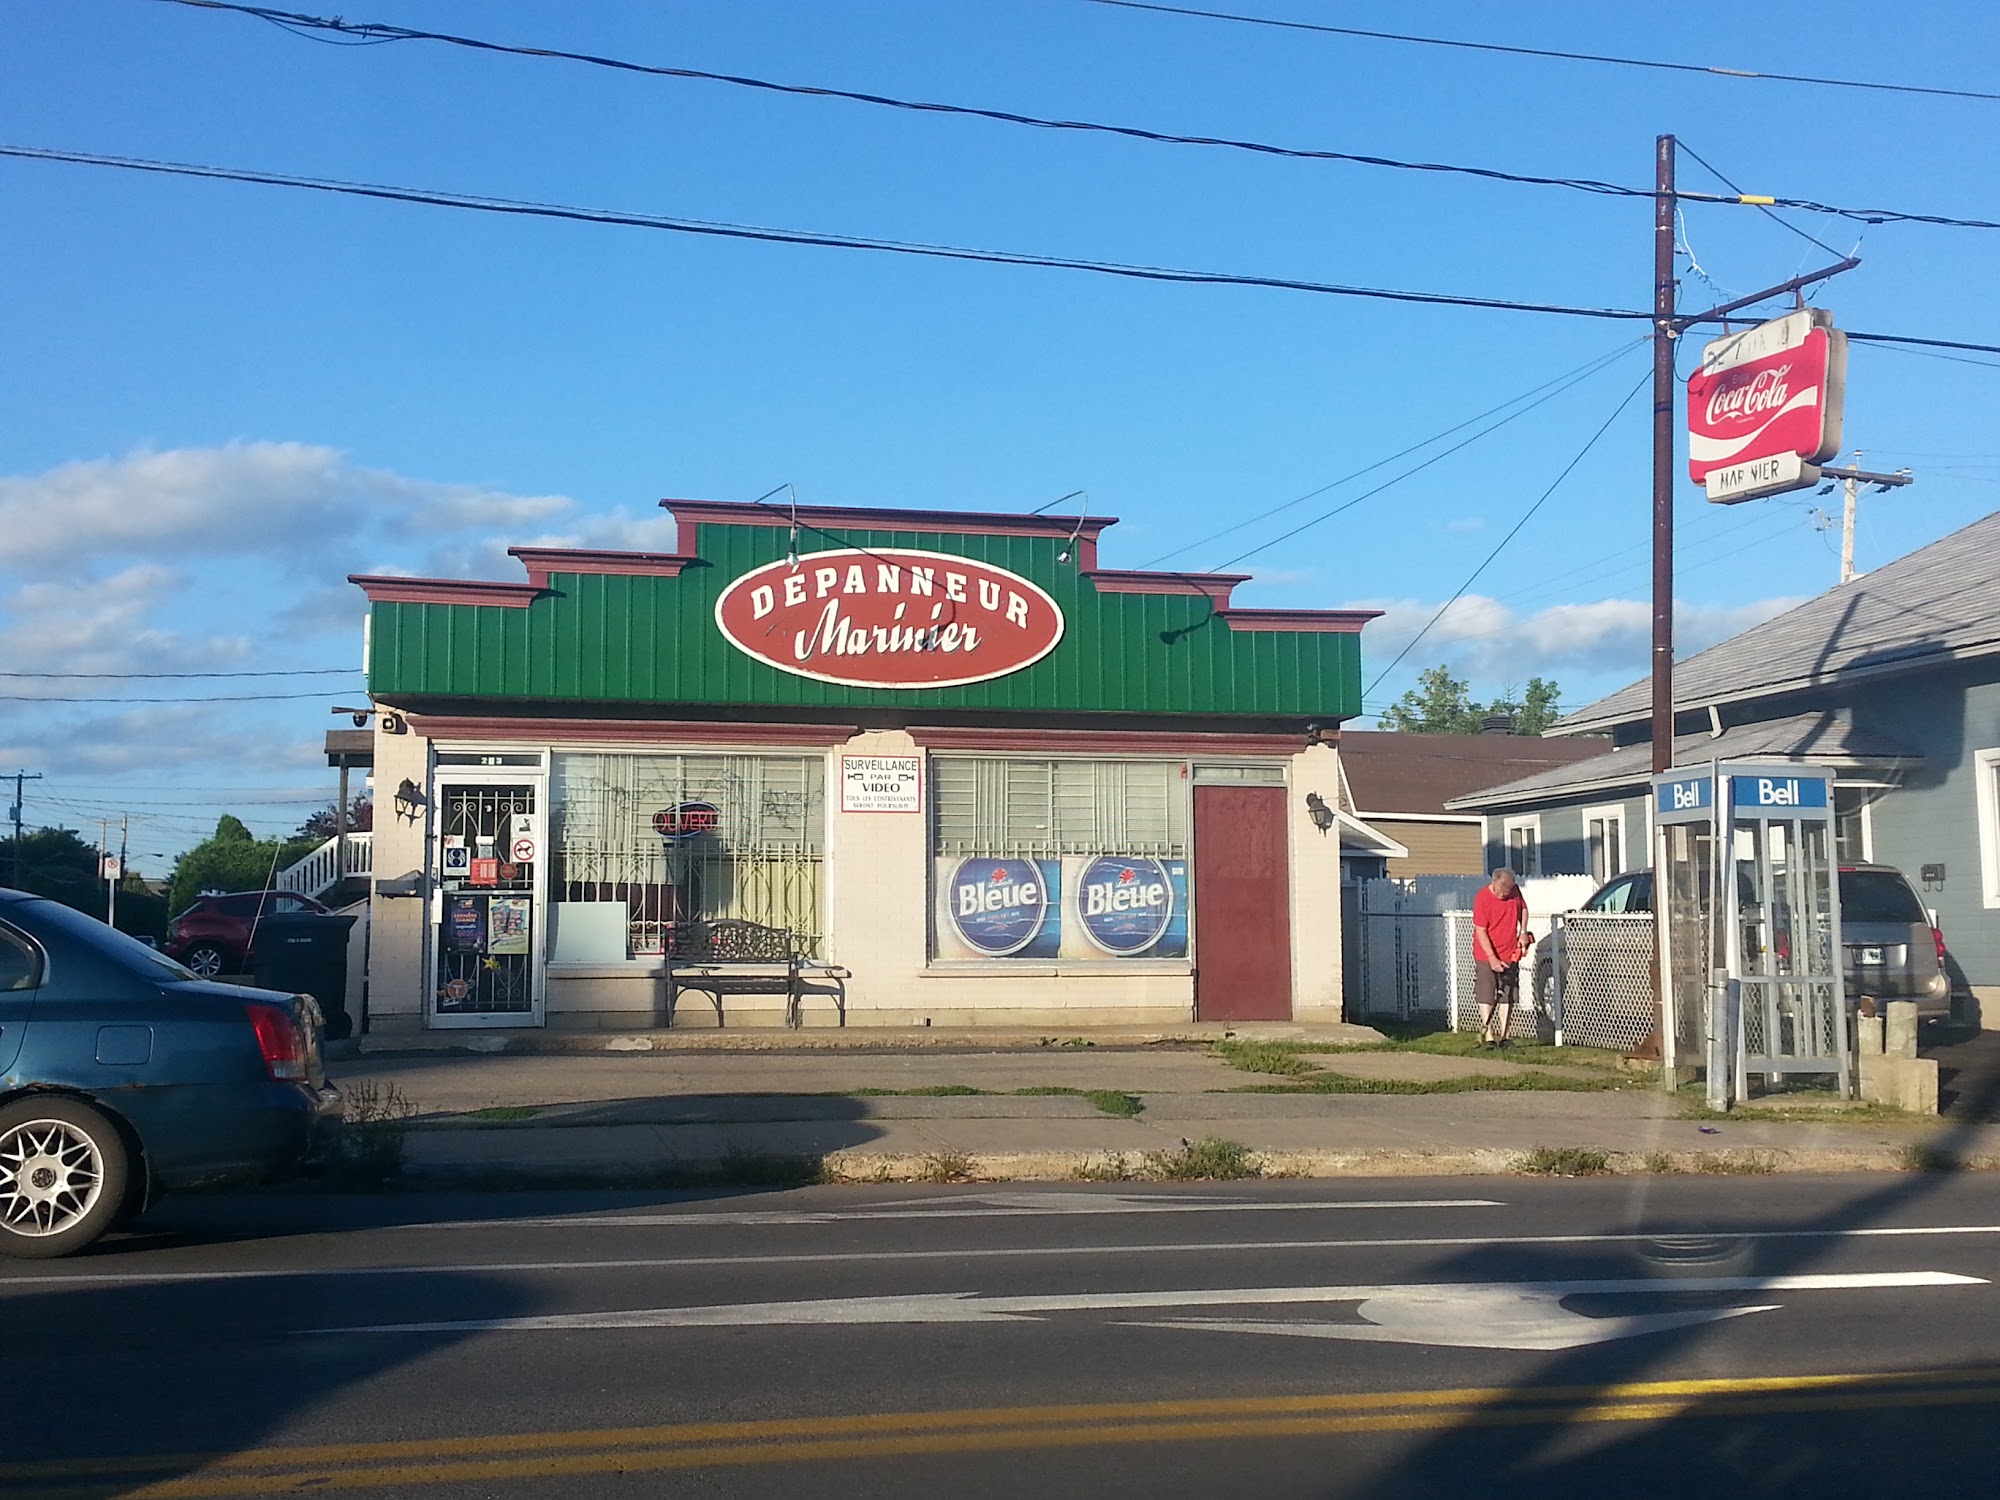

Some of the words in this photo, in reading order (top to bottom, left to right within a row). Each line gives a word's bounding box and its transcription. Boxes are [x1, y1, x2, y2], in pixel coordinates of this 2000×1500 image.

[1706, 363, 1793, 425] Coca-Cola
[750, 564, 1028, 630] DÉPANNEUR
[794, 598, 982, 661] Marinier
[844, 759, 917, 771] SURVEILLANCE
[862, 782, 901, 792] VIDEO
[1673, 781, 1699, 809] Bell
[1758, 779, 1799, 805] Bell
[653, 810, 716, 831] OUVERT
[959, 881, 1037, 916] Bleue
[1087, 882, 1164, 915] Bleue
